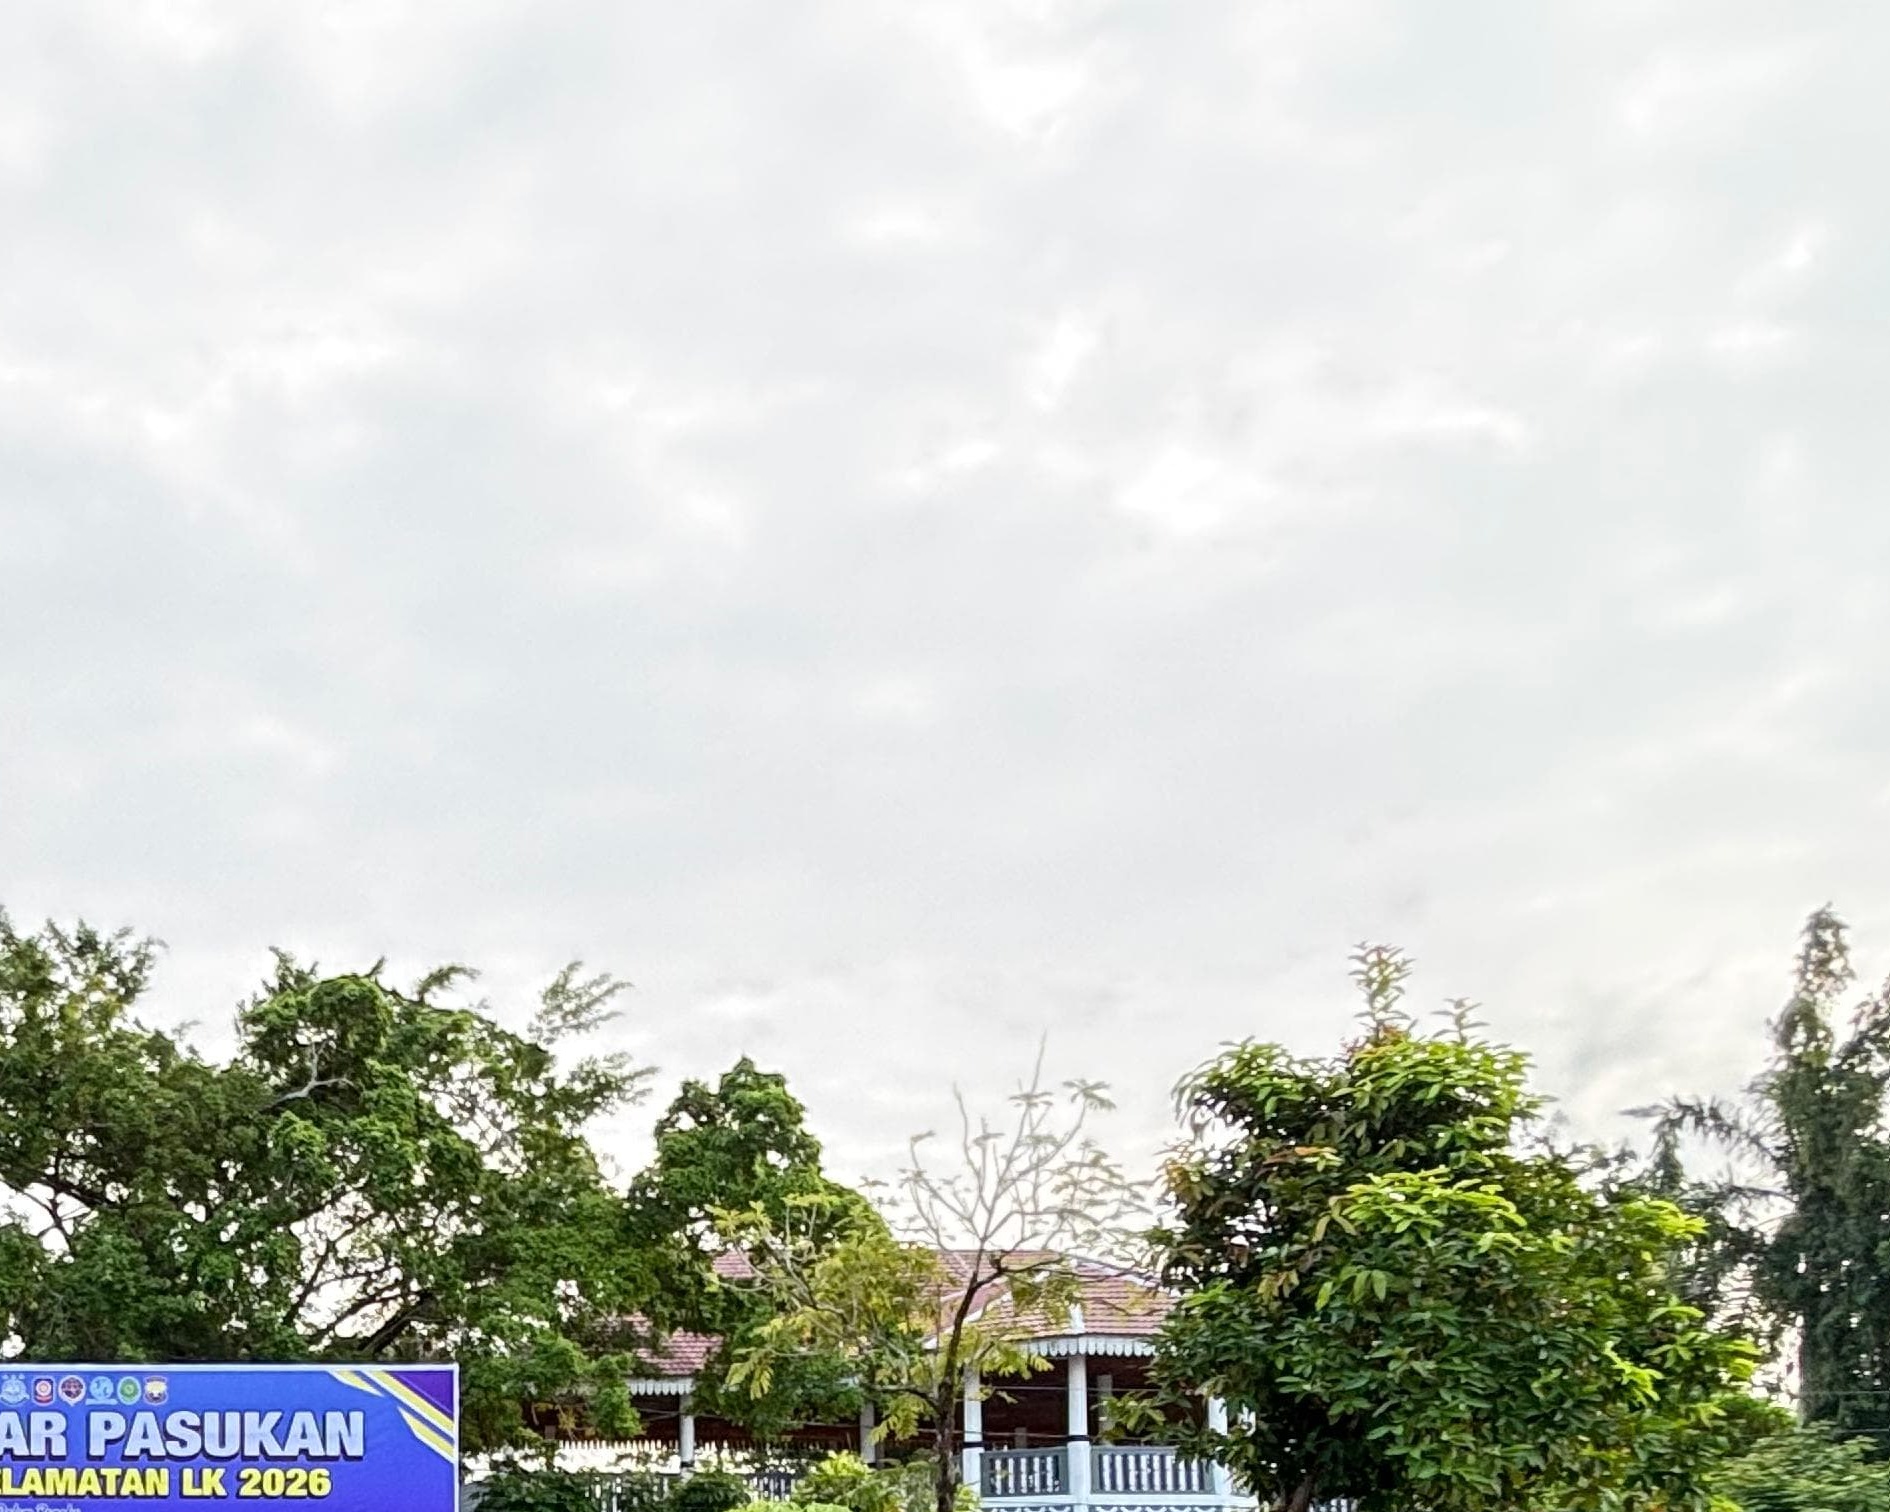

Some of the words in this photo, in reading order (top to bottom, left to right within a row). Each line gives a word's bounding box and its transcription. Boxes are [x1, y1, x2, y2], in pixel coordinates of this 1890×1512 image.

[89, 1411, 364, 1458] PASUKAN
[182, 1468, 227, 1496] LK
[239, 1468, 332, 1496] 2026
